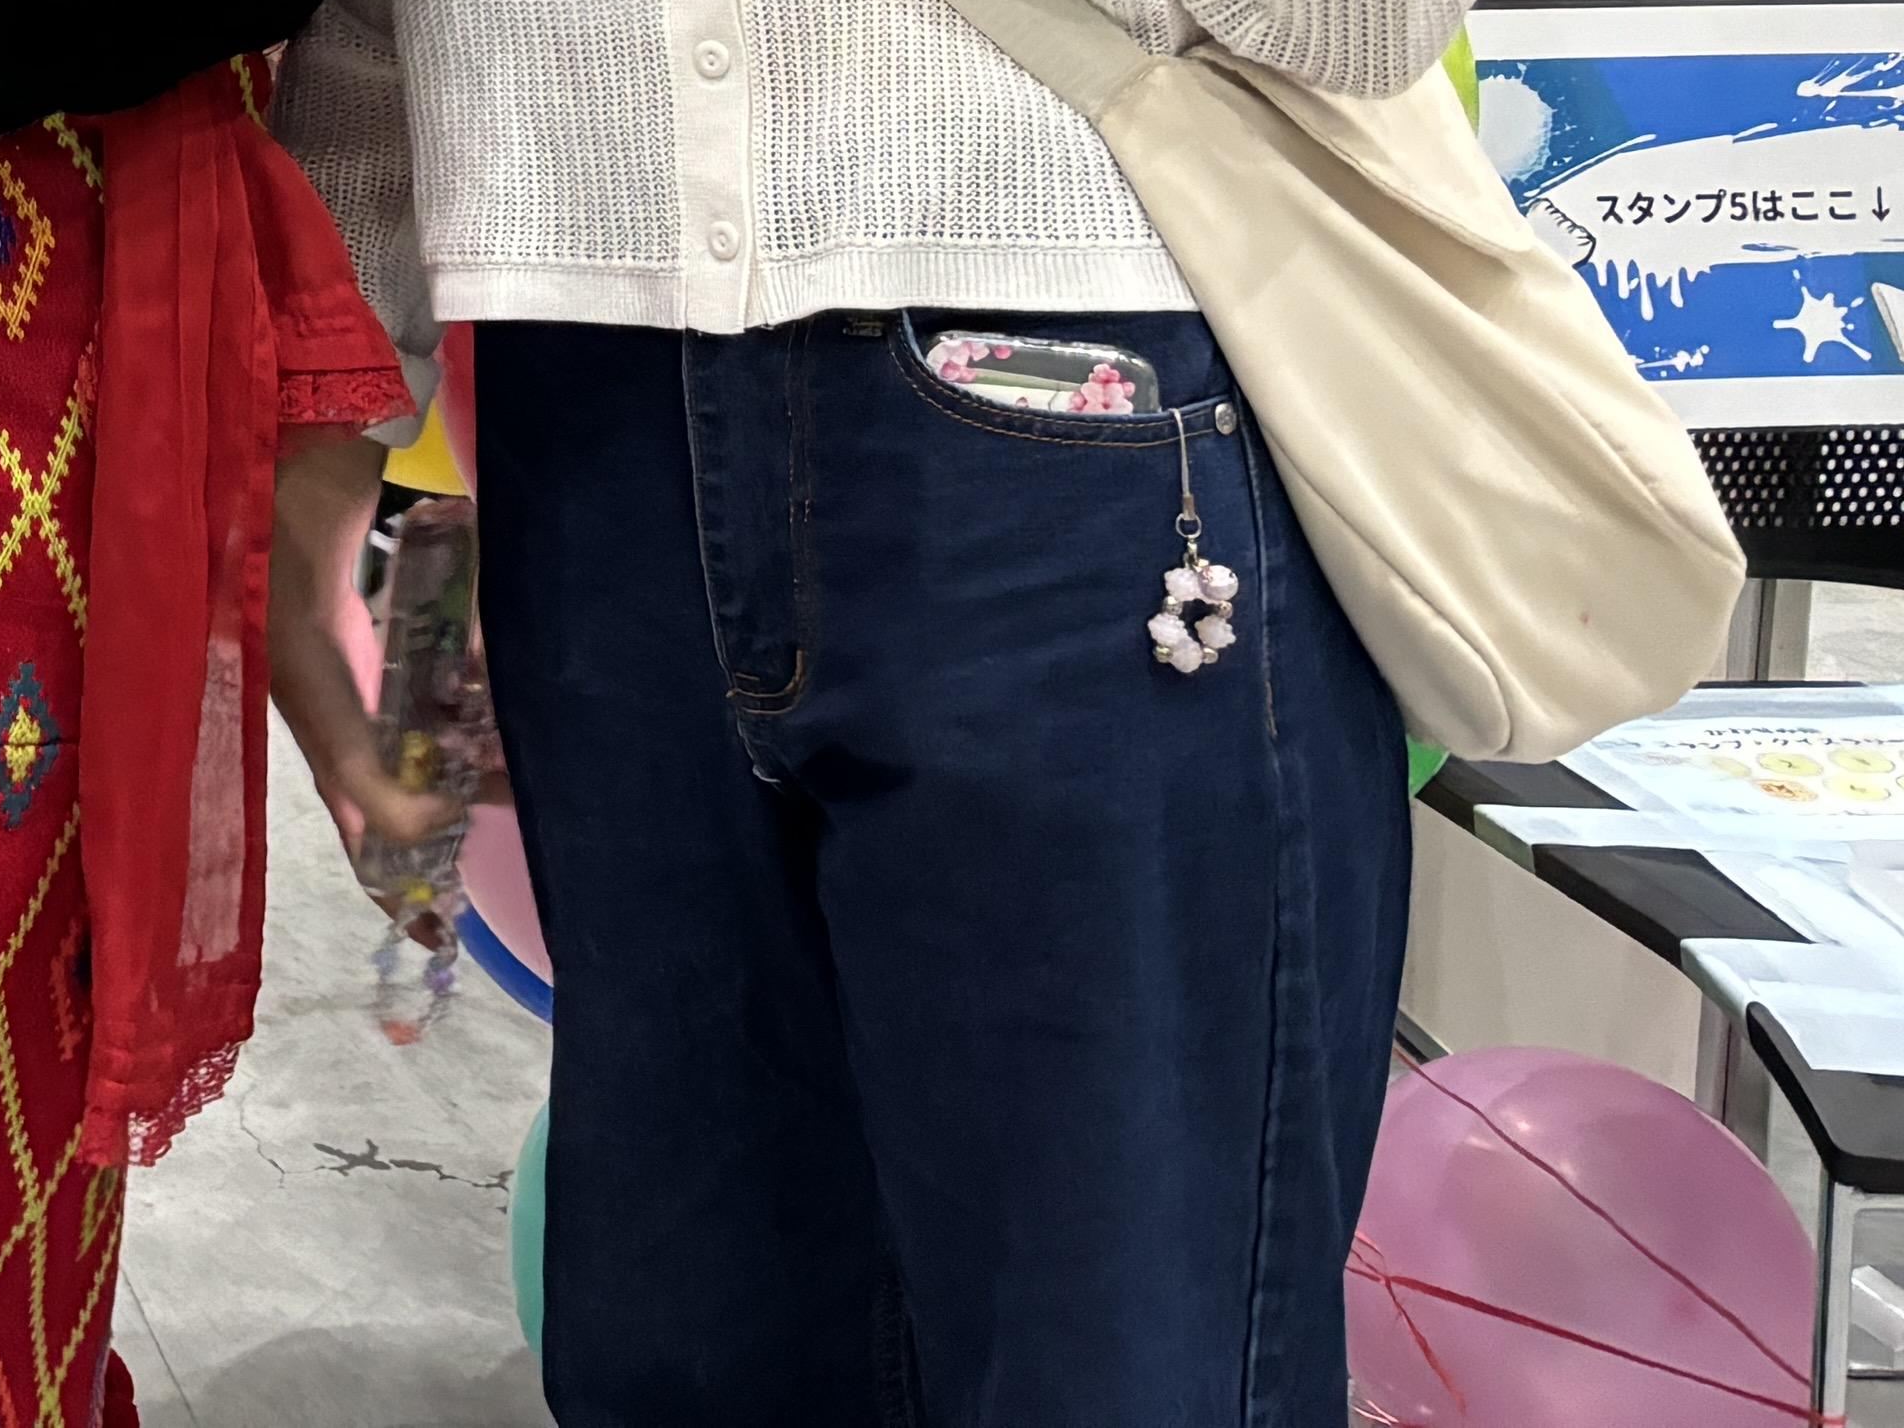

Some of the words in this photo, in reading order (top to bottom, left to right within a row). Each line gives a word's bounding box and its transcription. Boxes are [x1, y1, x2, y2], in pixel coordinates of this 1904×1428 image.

[1596, 189, 1857, 225] スタンプ5はここ
